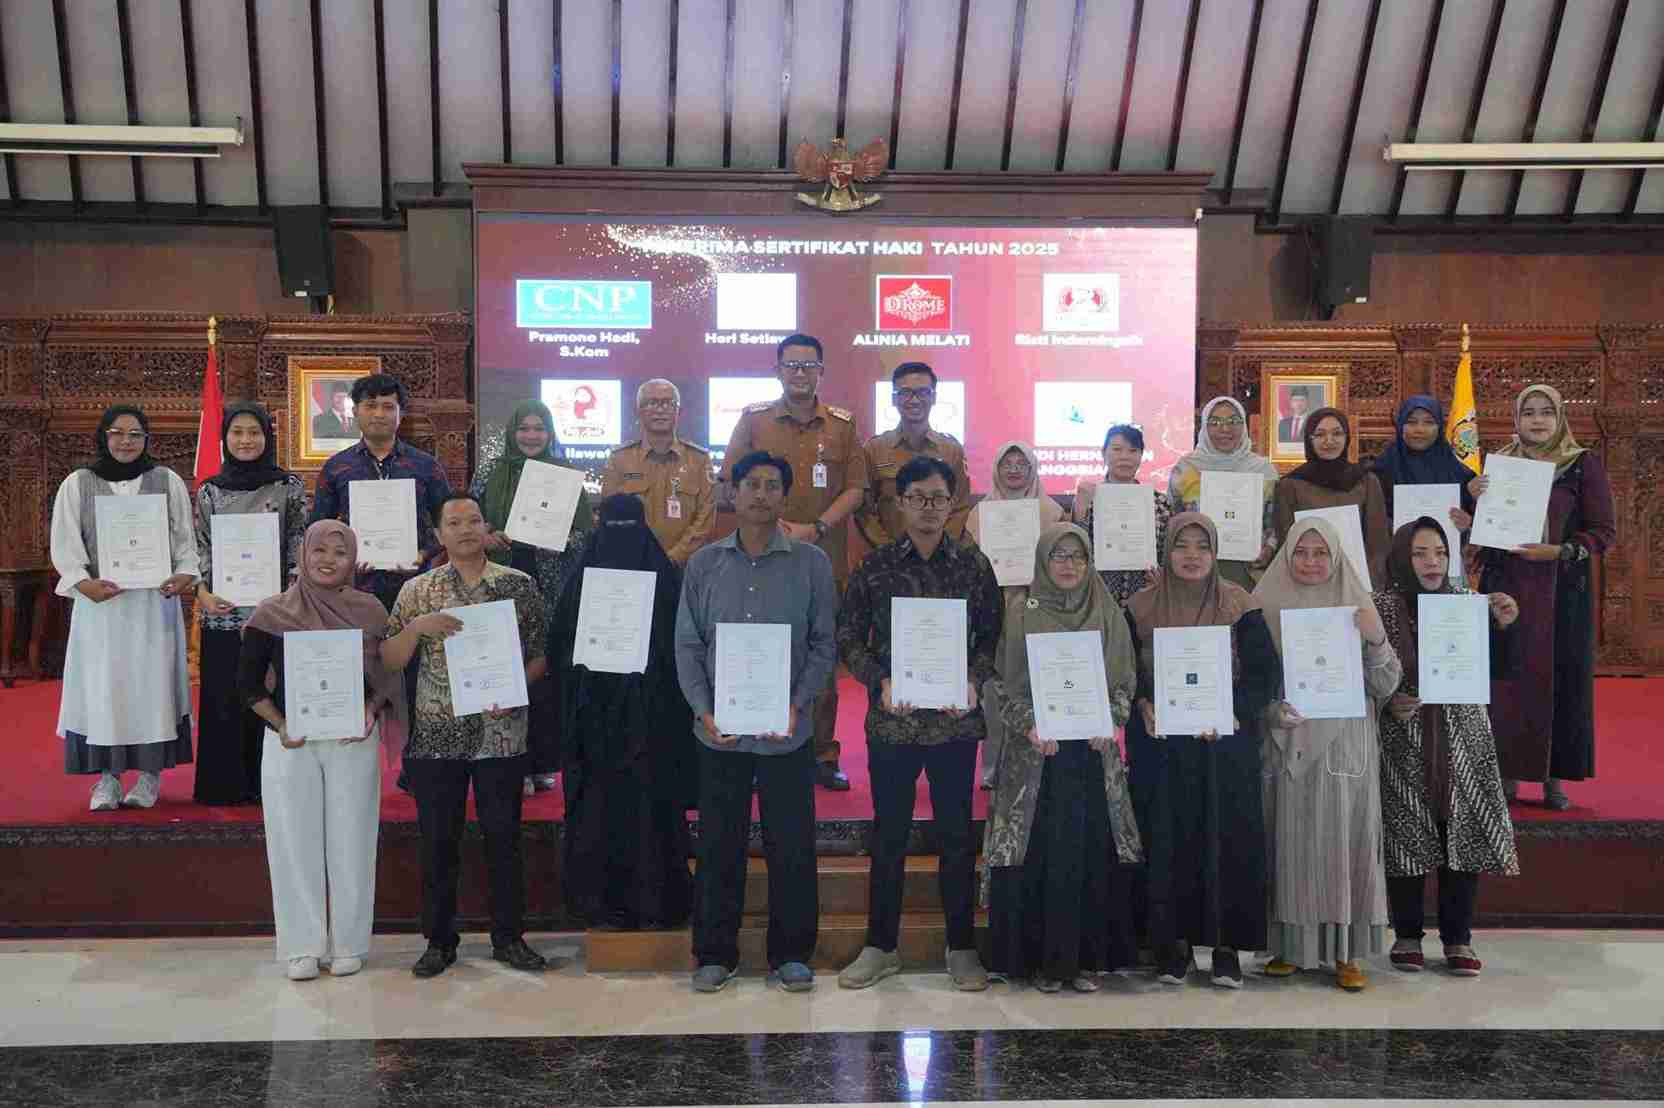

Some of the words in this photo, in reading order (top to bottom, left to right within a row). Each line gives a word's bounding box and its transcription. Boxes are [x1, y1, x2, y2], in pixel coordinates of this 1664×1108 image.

[753, 240, 869, 255] SERTIFIKAT
[873, 241, 923, 255] HAKI
[931, 241, 1004, 255] TAHUN
[1008, 242, 1060, 256] 2025
[534, 285, 637, 312] CNP
[704, 332, 737, 345] Hari
[852, 334, 908, 346] ALINIA
[911, 334, 970, 346] MELATI
